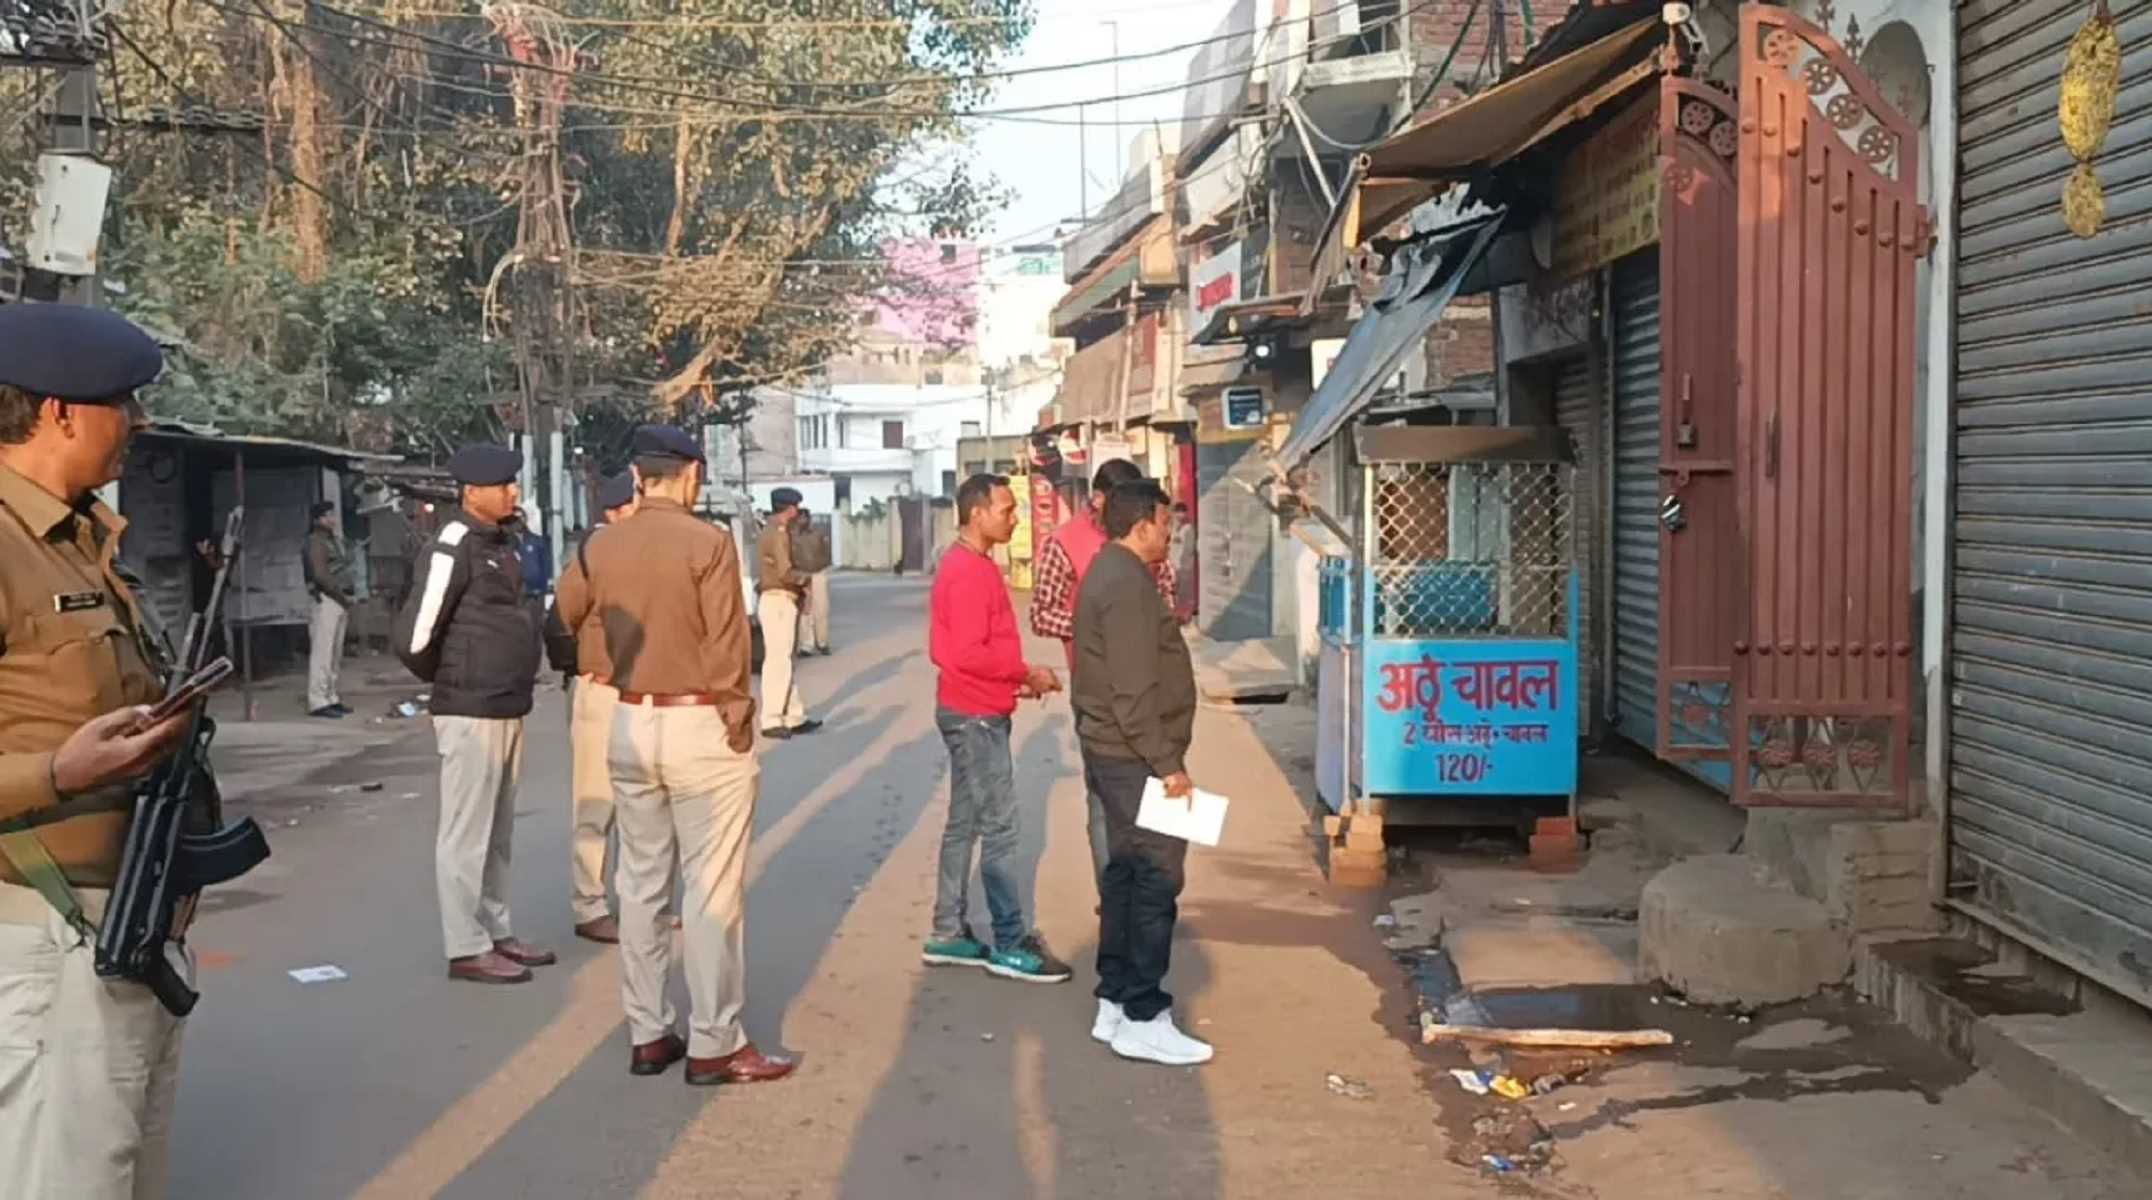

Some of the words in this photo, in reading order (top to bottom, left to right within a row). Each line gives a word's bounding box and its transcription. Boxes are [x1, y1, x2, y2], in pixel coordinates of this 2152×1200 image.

[1451, 660, 1559, 710] चावल
[1403, 722, 1416, 744] 2
[1435, 753, 1493, 782] 120/-
